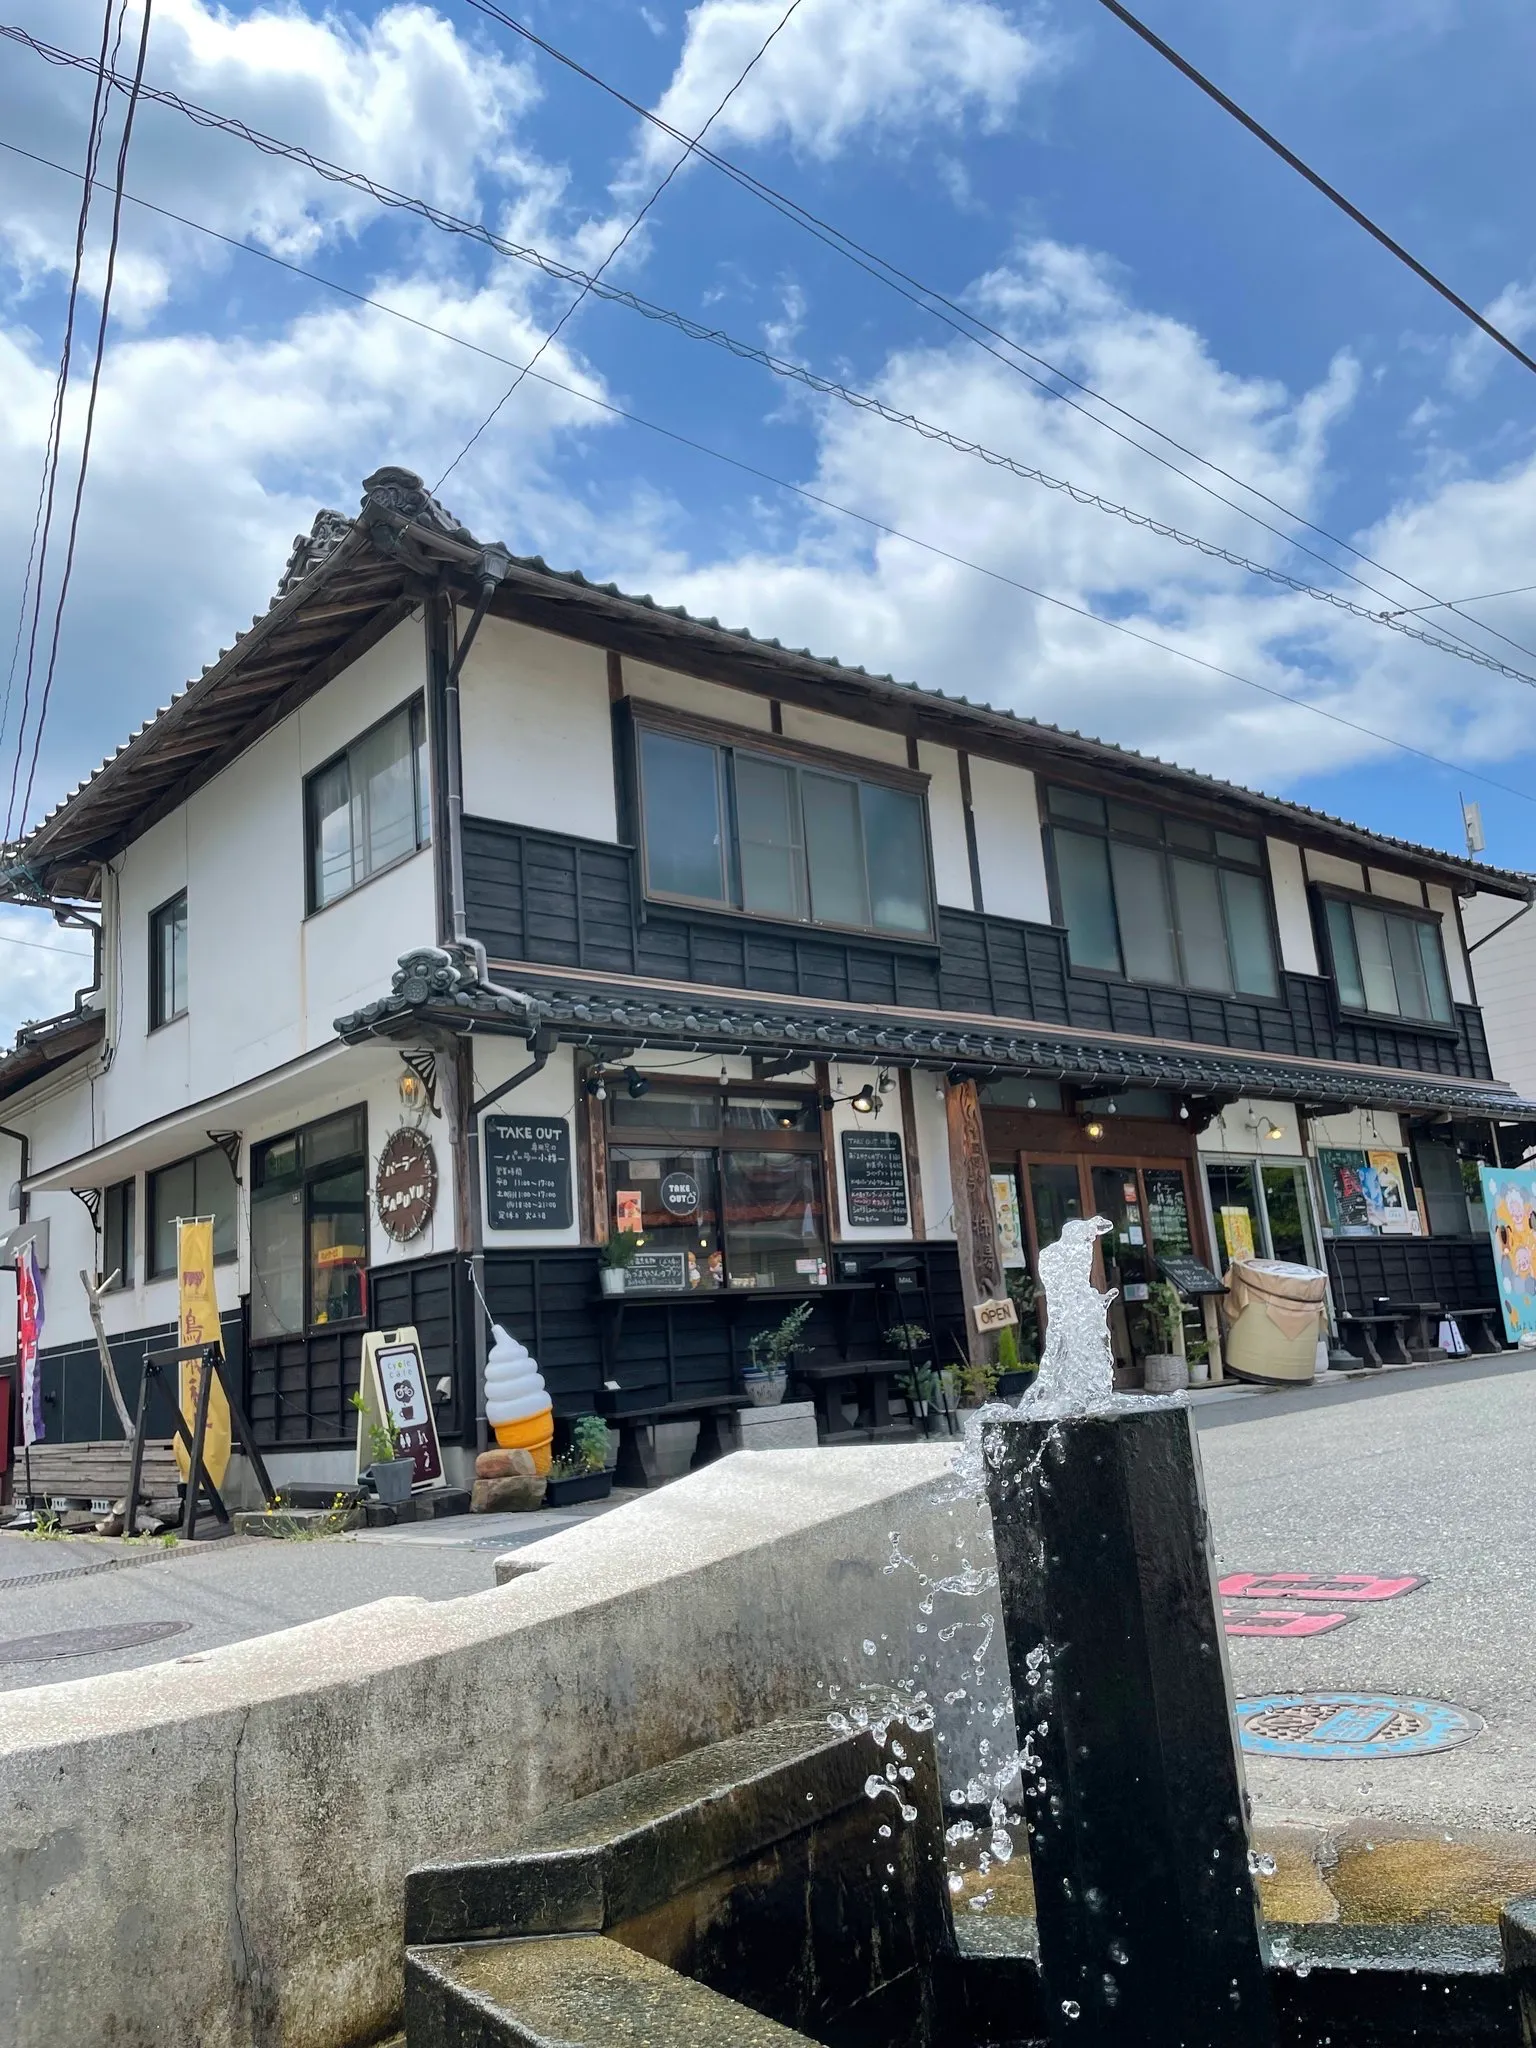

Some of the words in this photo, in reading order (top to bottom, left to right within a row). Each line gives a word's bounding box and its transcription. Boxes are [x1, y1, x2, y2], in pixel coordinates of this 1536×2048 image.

[496, 1126, 532, 1140] TAKE
[535, 1127, 562, 1140] OUT
[668, 1184, 690, 1193] TAKE
[383, 1184, 424, 1212] KABUYU
[669, 1194, 686, 1203] OUT
[981, 1305, 1011, 1324] OPEN
